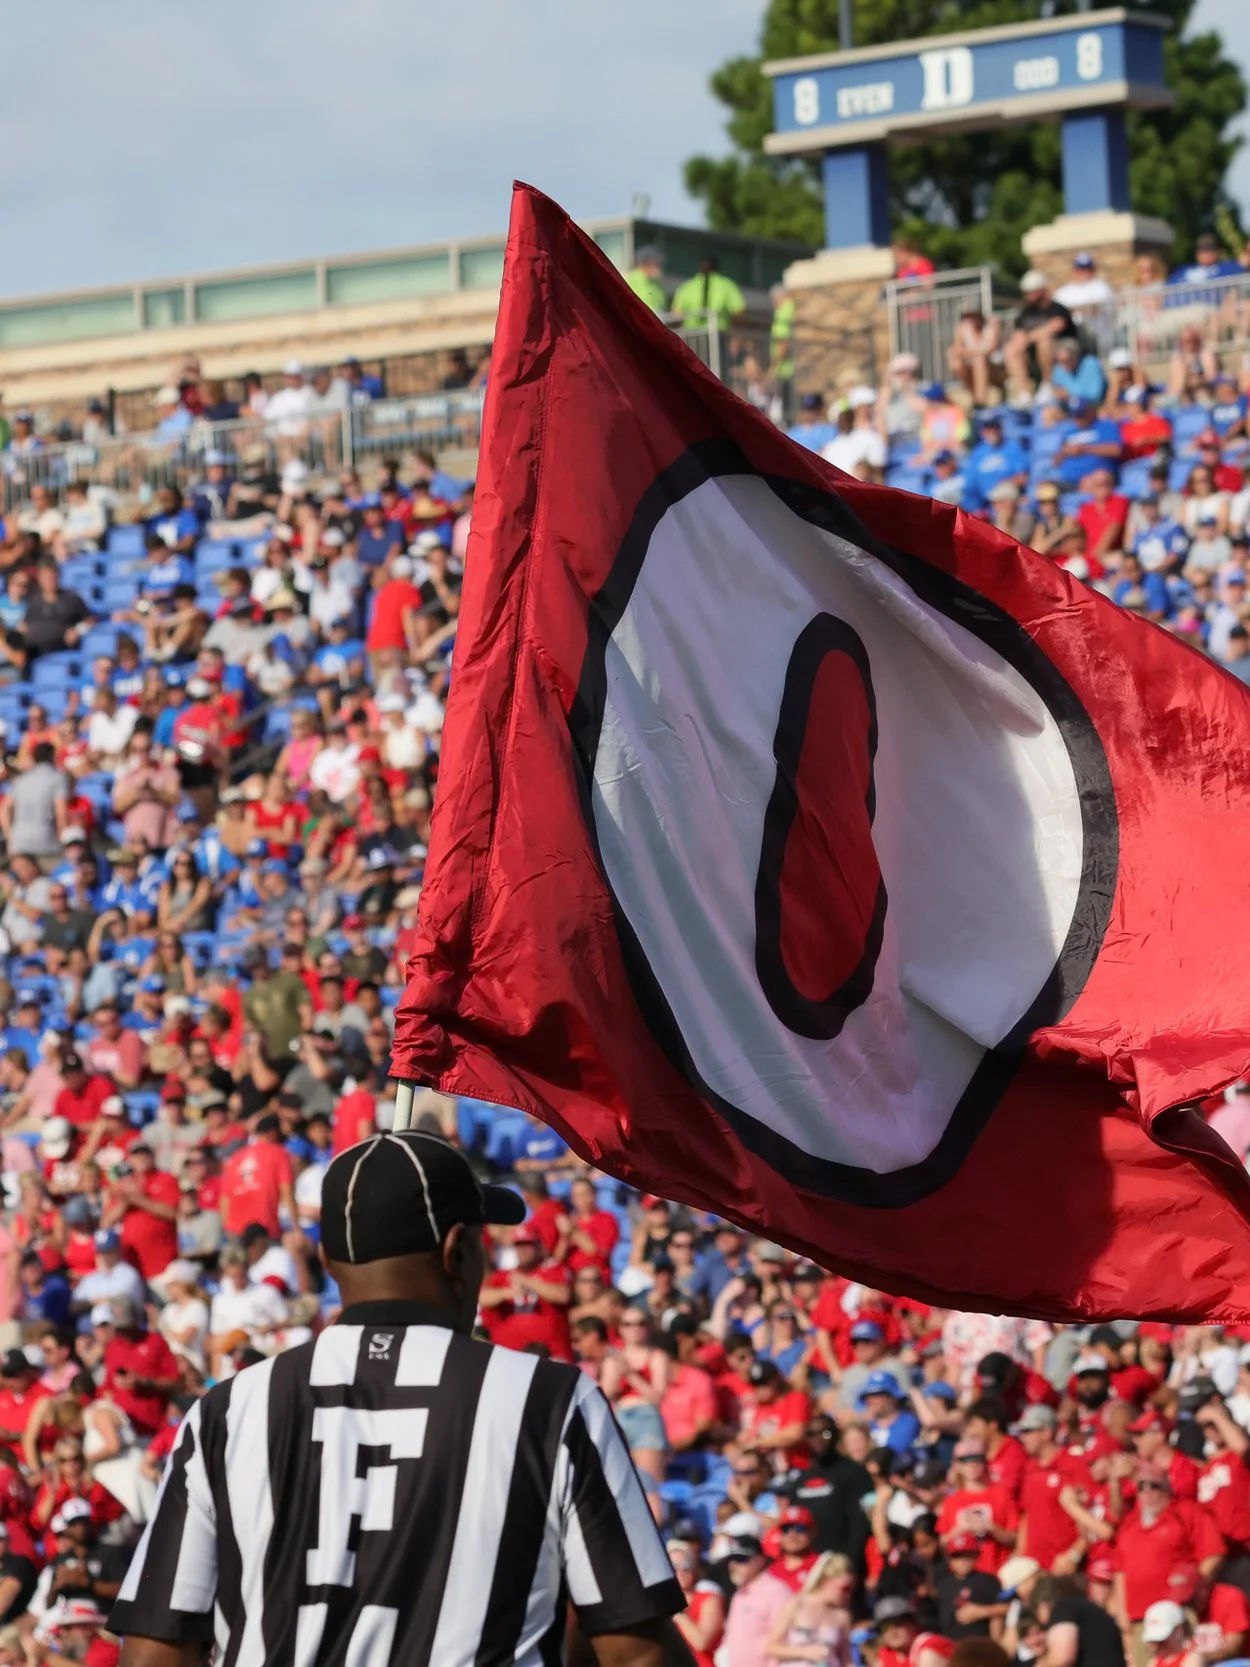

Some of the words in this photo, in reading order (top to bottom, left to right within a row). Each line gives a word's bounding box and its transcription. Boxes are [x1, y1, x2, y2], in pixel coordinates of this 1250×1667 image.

[837, 81, 895, 118] EVEN
[919, 47, 974, 111] D
[1077, 32, 1102, 80] 8
[306, 1407, 429, 1588] F
